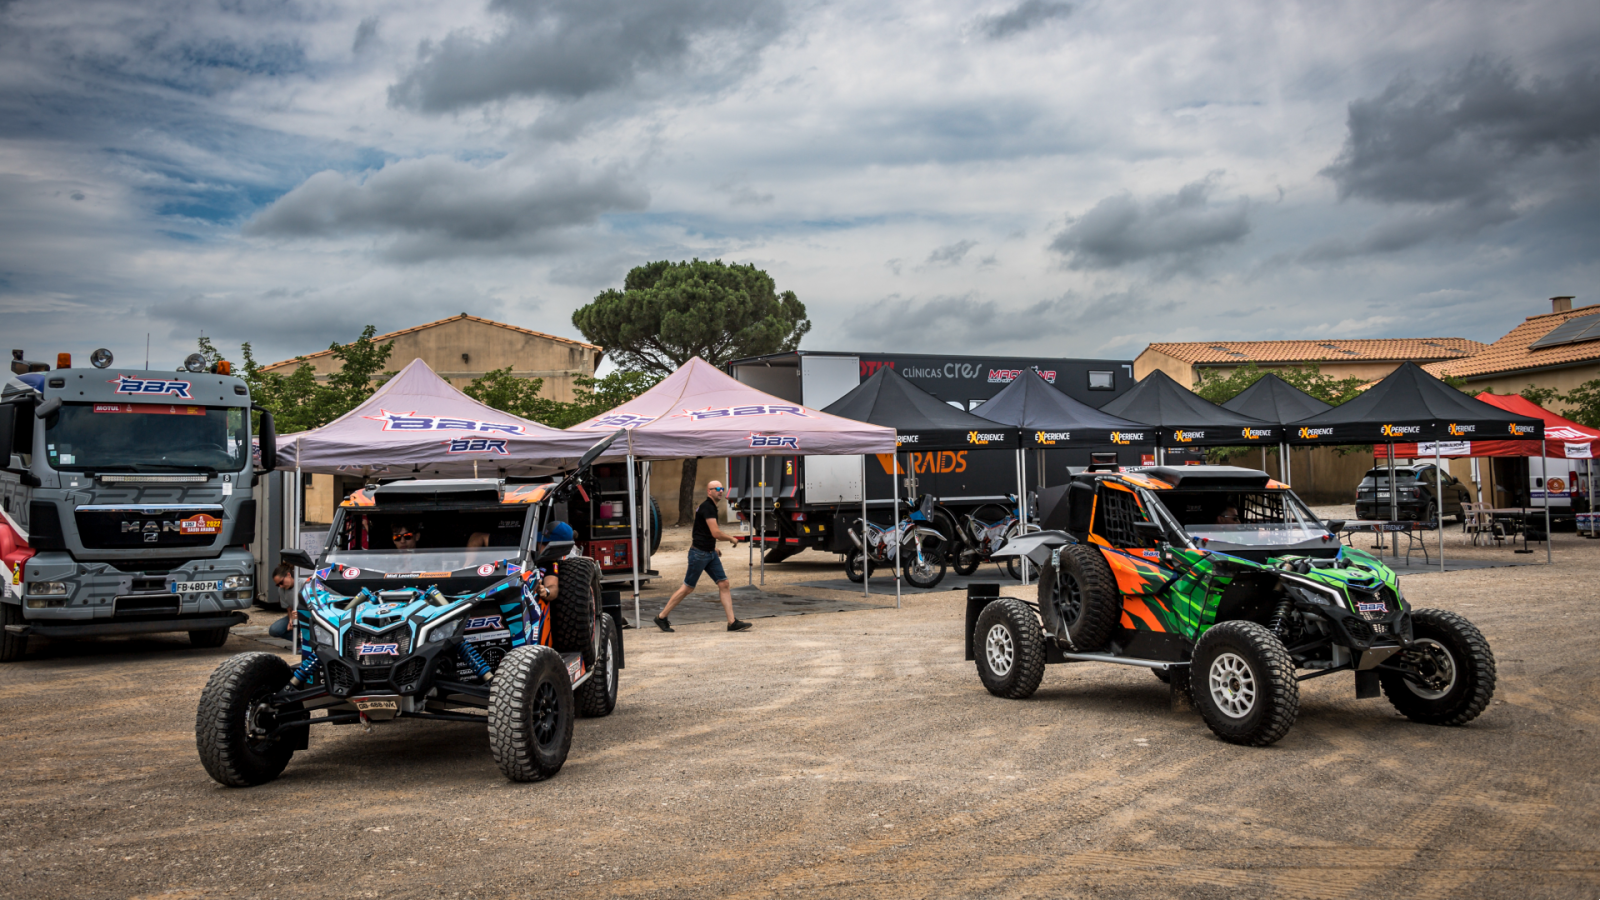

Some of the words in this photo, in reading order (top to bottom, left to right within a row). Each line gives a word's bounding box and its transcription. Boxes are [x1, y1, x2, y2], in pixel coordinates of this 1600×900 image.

[903, 367, 942, 378] CLÍNICAS
[943, 363, 982, 379] cres
[118, 377, 193, 399] BBR
[690, 401, 813, 421] BBR
[386, 414, 526, 437] BBR
[1380, 424, 1420, 436] EXPERIENCE
[750, 434, 800, 450] BBR
[966, 430, 1005, 444] EXPERIENCE
[1034, 430, 1071, 444] EXPERIENCE
[1110, 431, 1145, 444] EXPERIENCE
[448, 438, 509, 454] BBR
[908, 450, 968, 474] RAIDS
[121, 520, 180, 532] MAN
[1357, 602, 1388, 612] BBR
[360, 643, 399, 655] BBR
